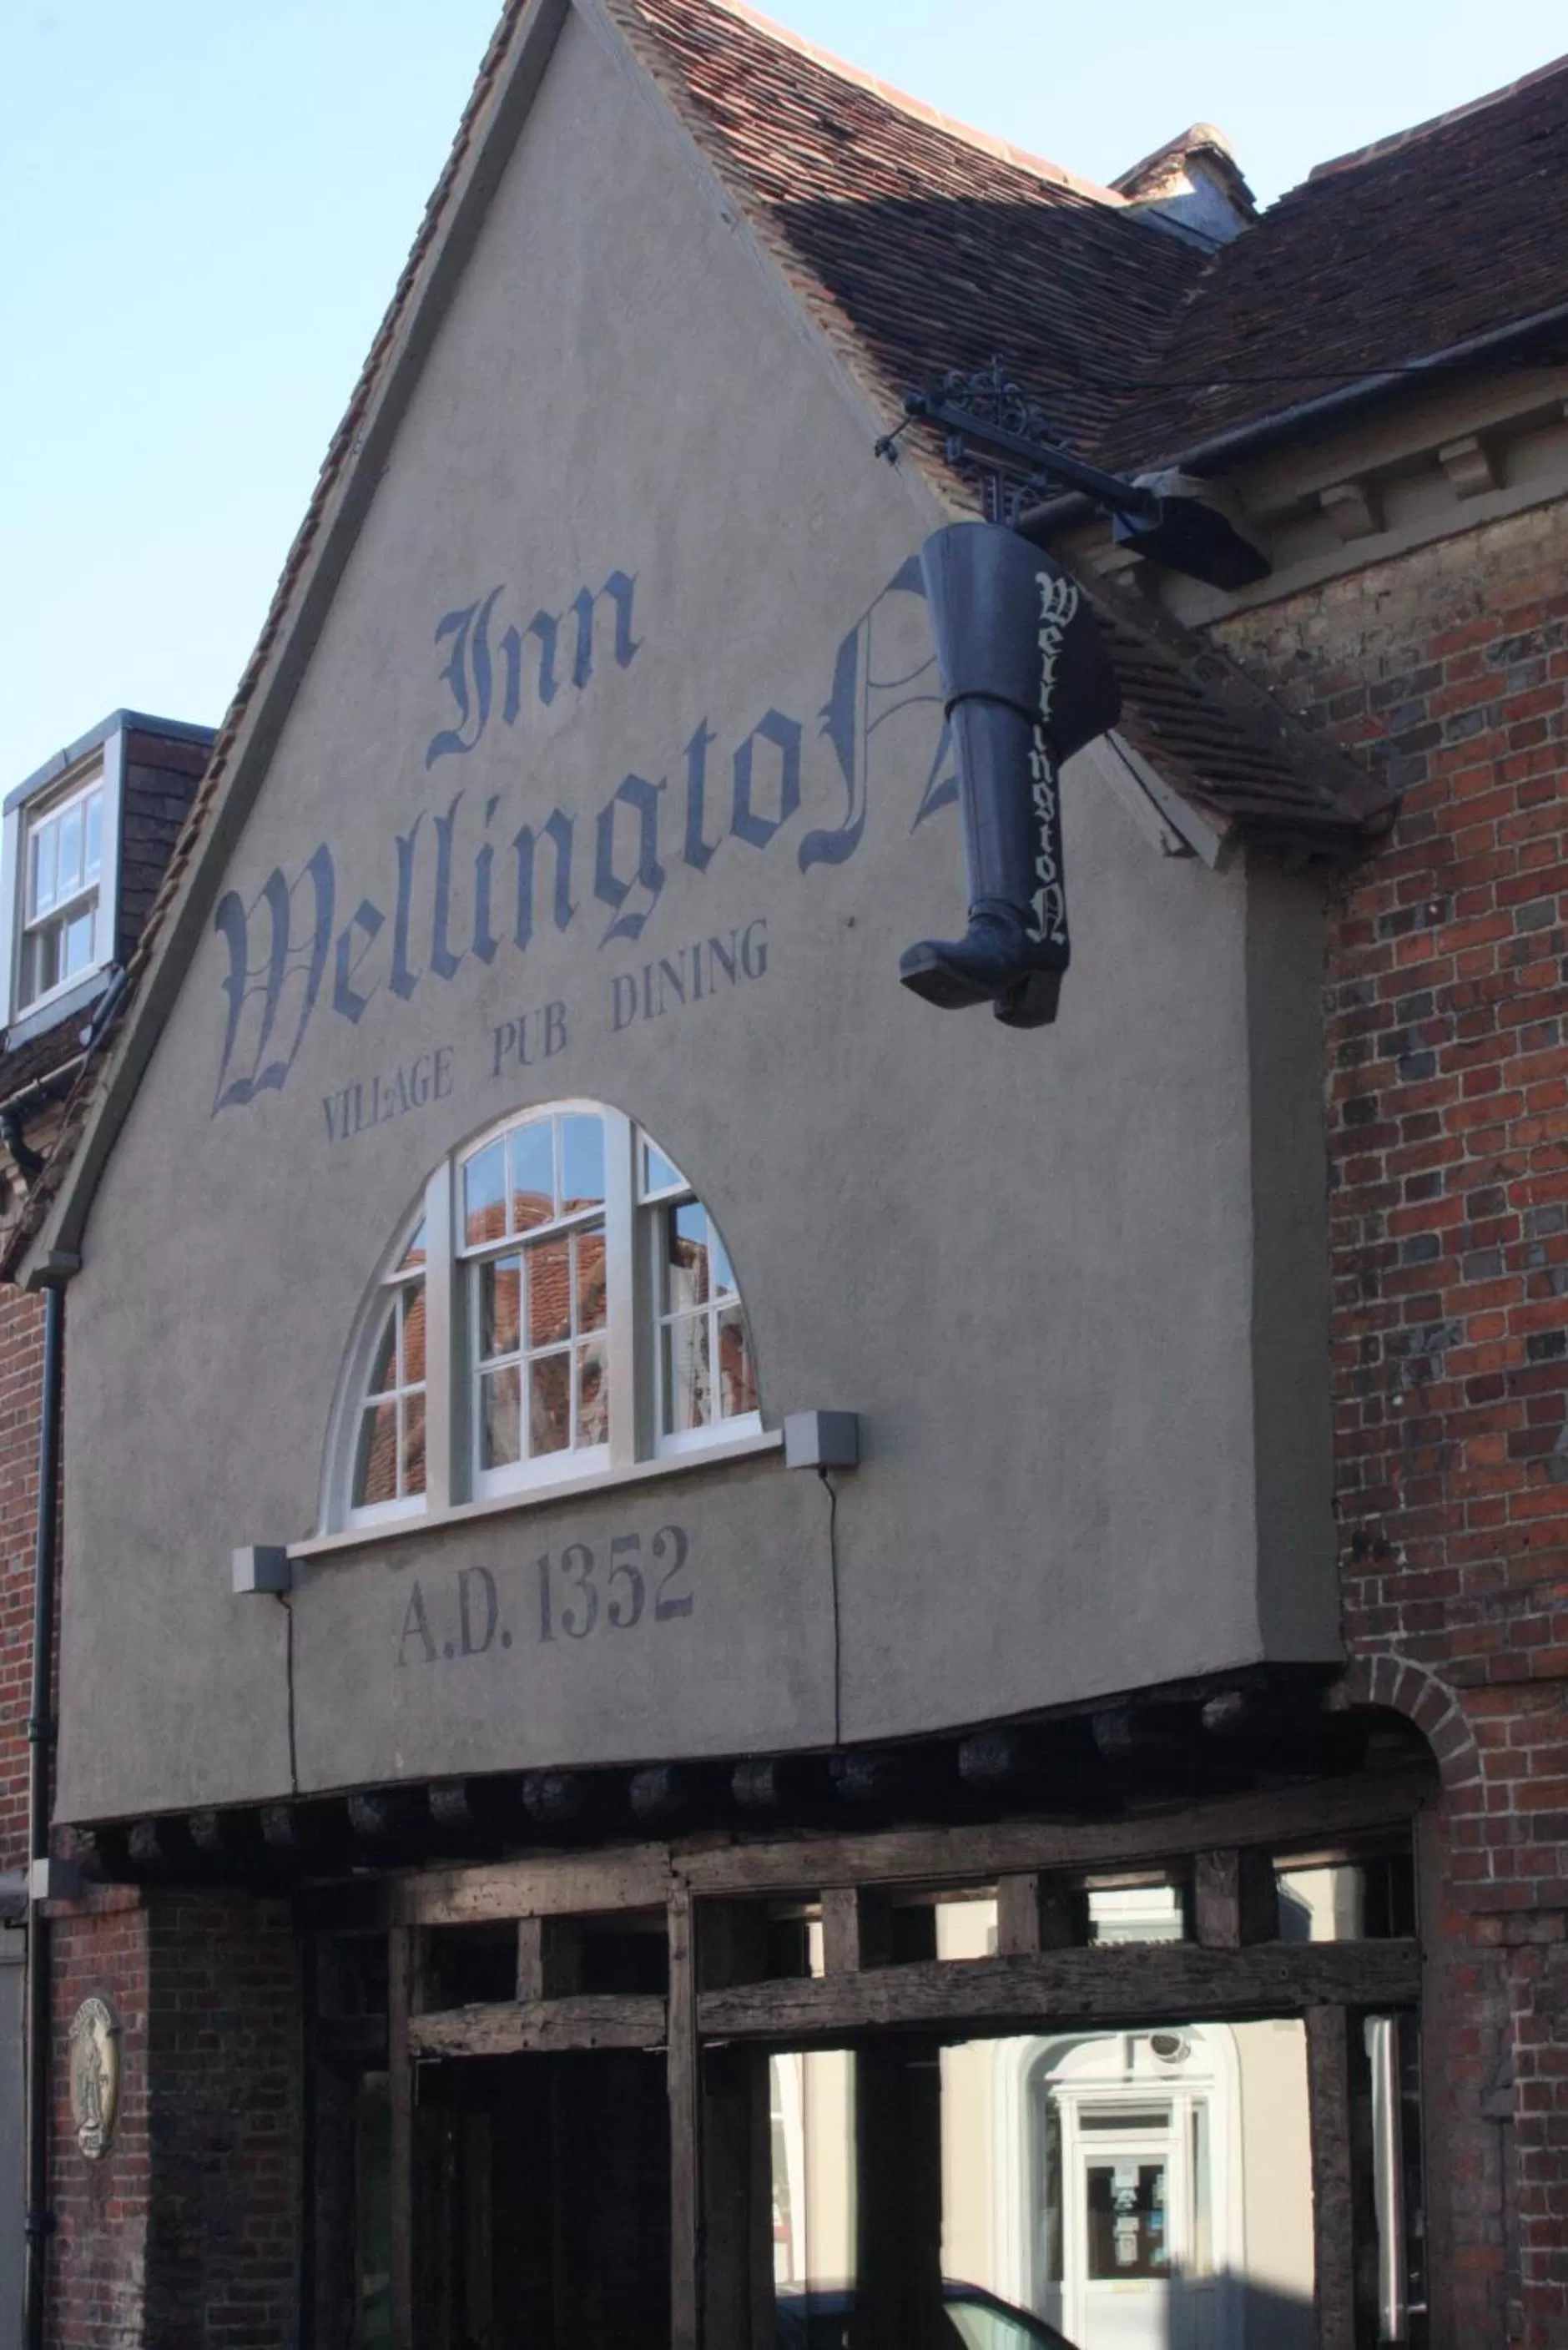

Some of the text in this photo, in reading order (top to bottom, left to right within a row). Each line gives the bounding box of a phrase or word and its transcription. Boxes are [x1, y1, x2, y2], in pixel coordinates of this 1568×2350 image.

[426, 569, 643, 769] Inn
[322, 918, 769, 1146] VILLAGE PUB DINING
[396, 1525, 694, 1667] A.D. 1352
